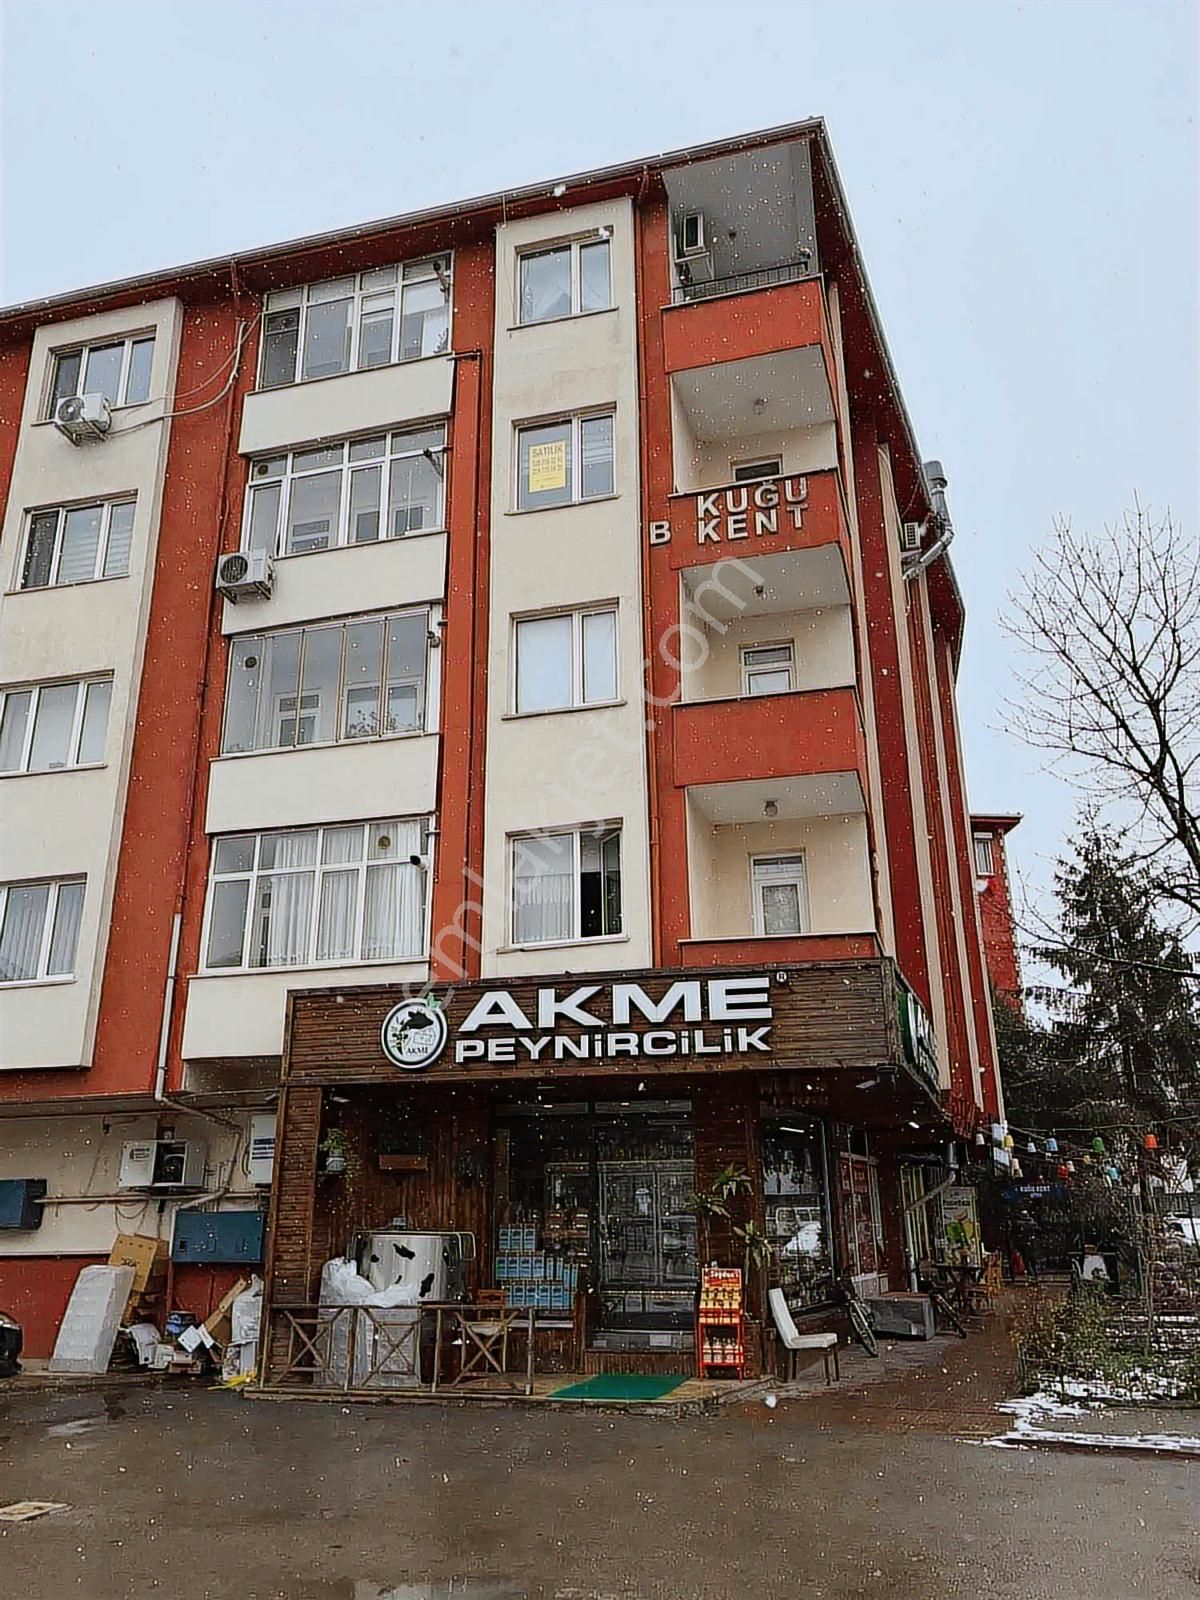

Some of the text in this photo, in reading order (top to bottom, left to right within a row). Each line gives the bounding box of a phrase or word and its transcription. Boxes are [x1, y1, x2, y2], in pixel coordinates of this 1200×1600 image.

[697, 477, 808, 518] KUĞU
[649, 520, 671, 545] B
[698, 503, 808, 544] KENT
[458, 977, 773, 1032] AKME
